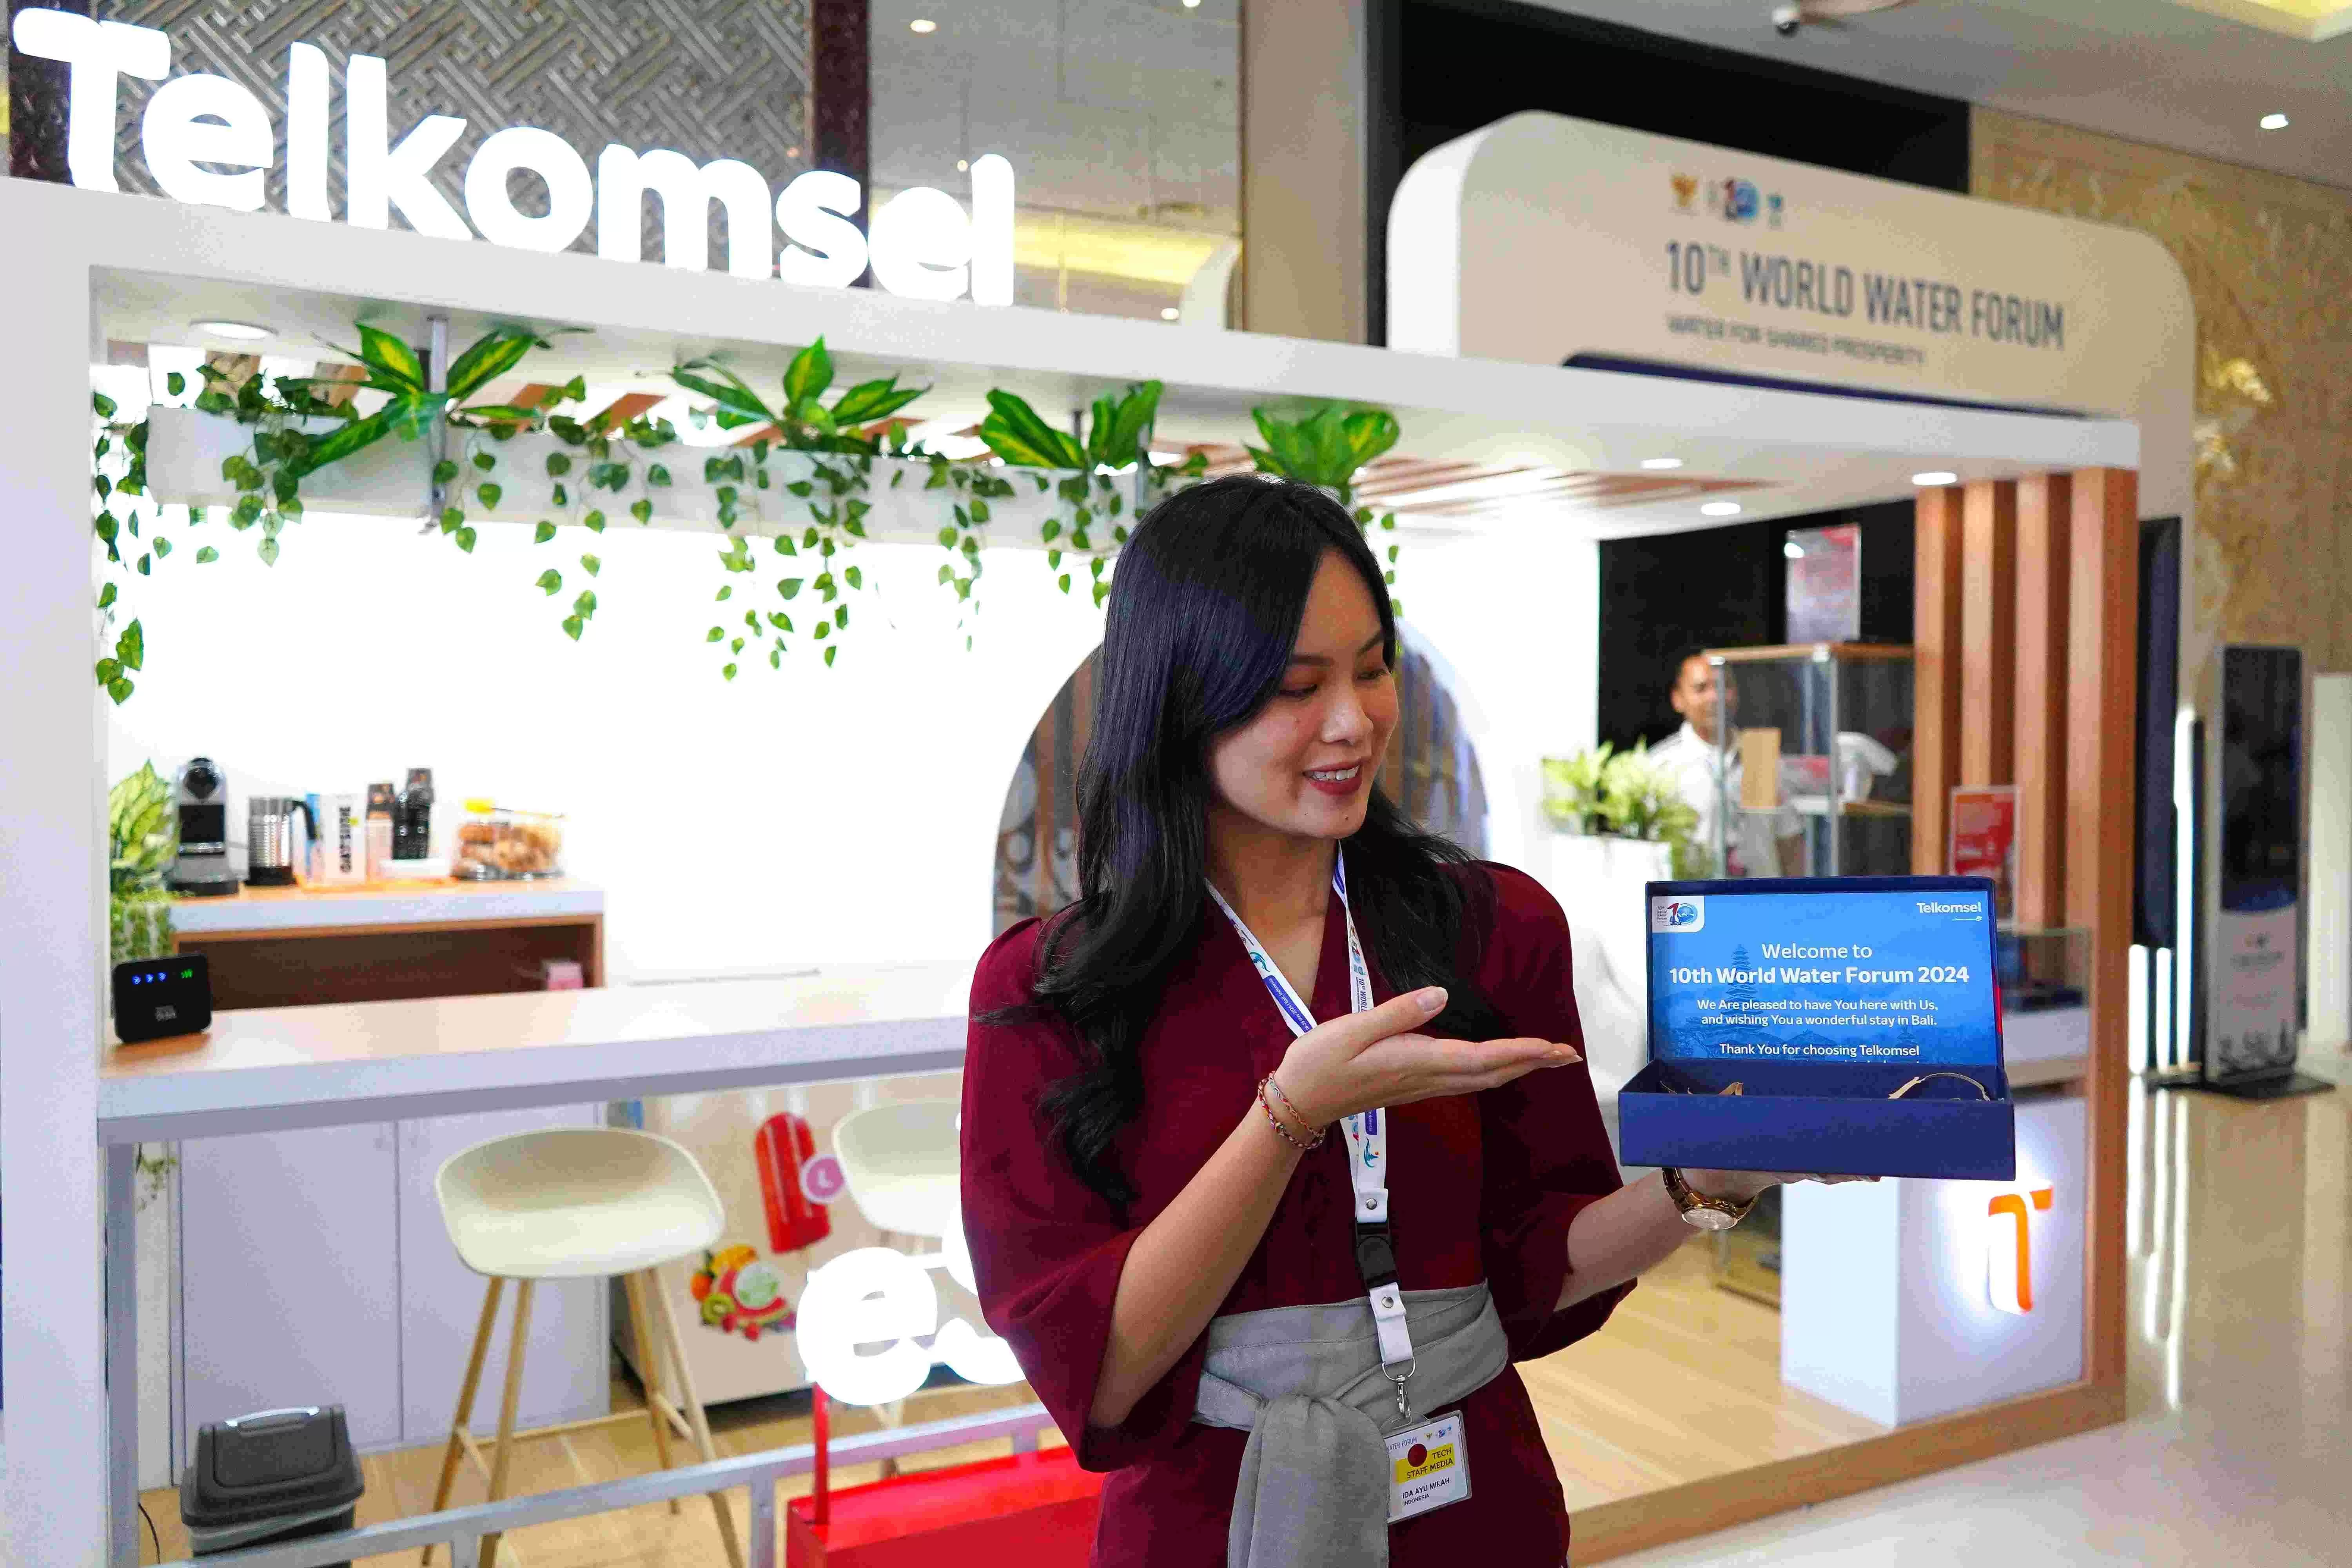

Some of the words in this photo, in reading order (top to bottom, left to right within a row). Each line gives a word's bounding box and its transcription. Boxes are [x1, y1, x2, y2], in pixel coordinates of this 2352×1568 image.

[13, 8, 1014, 307] Telkomsel
[1741, 251, 1854, 318] WORLD
[1863, 272, 1962, 334] WATER
[1971, 289, 2065, 350] FORUM
[1916, 901, 1982, 913] Telkomsel
[1762, 943, 1848, 959] Welcome
[1852, 944, 1872, 959] to
[1669, 967, 1712, 984] 10th
[1716, 967, 1775, 984] World
[1780, 967, 1841, 984] Water
[1846, 967, 1914, 983] Forum
[1918, 966, 1969, 983] 2024
[1697, 1000, 1716, 1010] We
[1719, 1000, 1739, 1010] Are
[1742, 1000, 1786, 1011] pleased
[1789, 1001, 1802, 1010] to
[1805, 1000, 1831, 1010] have
[1834, 1000, 1857, 1010] You
[1860, 1000, 1887, 1010] here
[1890, 1000, 1916, 1010] with
[1919, 1000, 1938, 1011] Us,
[1702, 1014, 1723, 1025] and
[1726, 1014, 1768, 1027] wishing
[1771, 1015, 1793, 1025] You
[1805, 1014, 1867, 1025] wonderful
[1869, 1016, 1895, 1027] stay
[1898, 1015, 1908, 1025] in
[1911, 1015, 1937, 1025] Bali.
[1719, 1044, 1755, 1054] Thank
[1757, 1044, 1780, 1054] You
[1782, 1044, 1800, 1054] for
[1803, 1045, 1857, 1057] choosing
[1859, 1045, 1920, 1056] Telkomsel
[1401, 1436, 1417, 1446] FORUM
[1432, 1447, 1452, 1459] TECH
[1407, 1466, 1428, 1479] STAFF
[1430, 1458, 1453, 1471] MEDIA
[1403, 1490, 1413, 1499] IDA
[1415, 1485, 1428, 1495] AYU
[1403, 1494, 1430, 1506] INDONESIA
